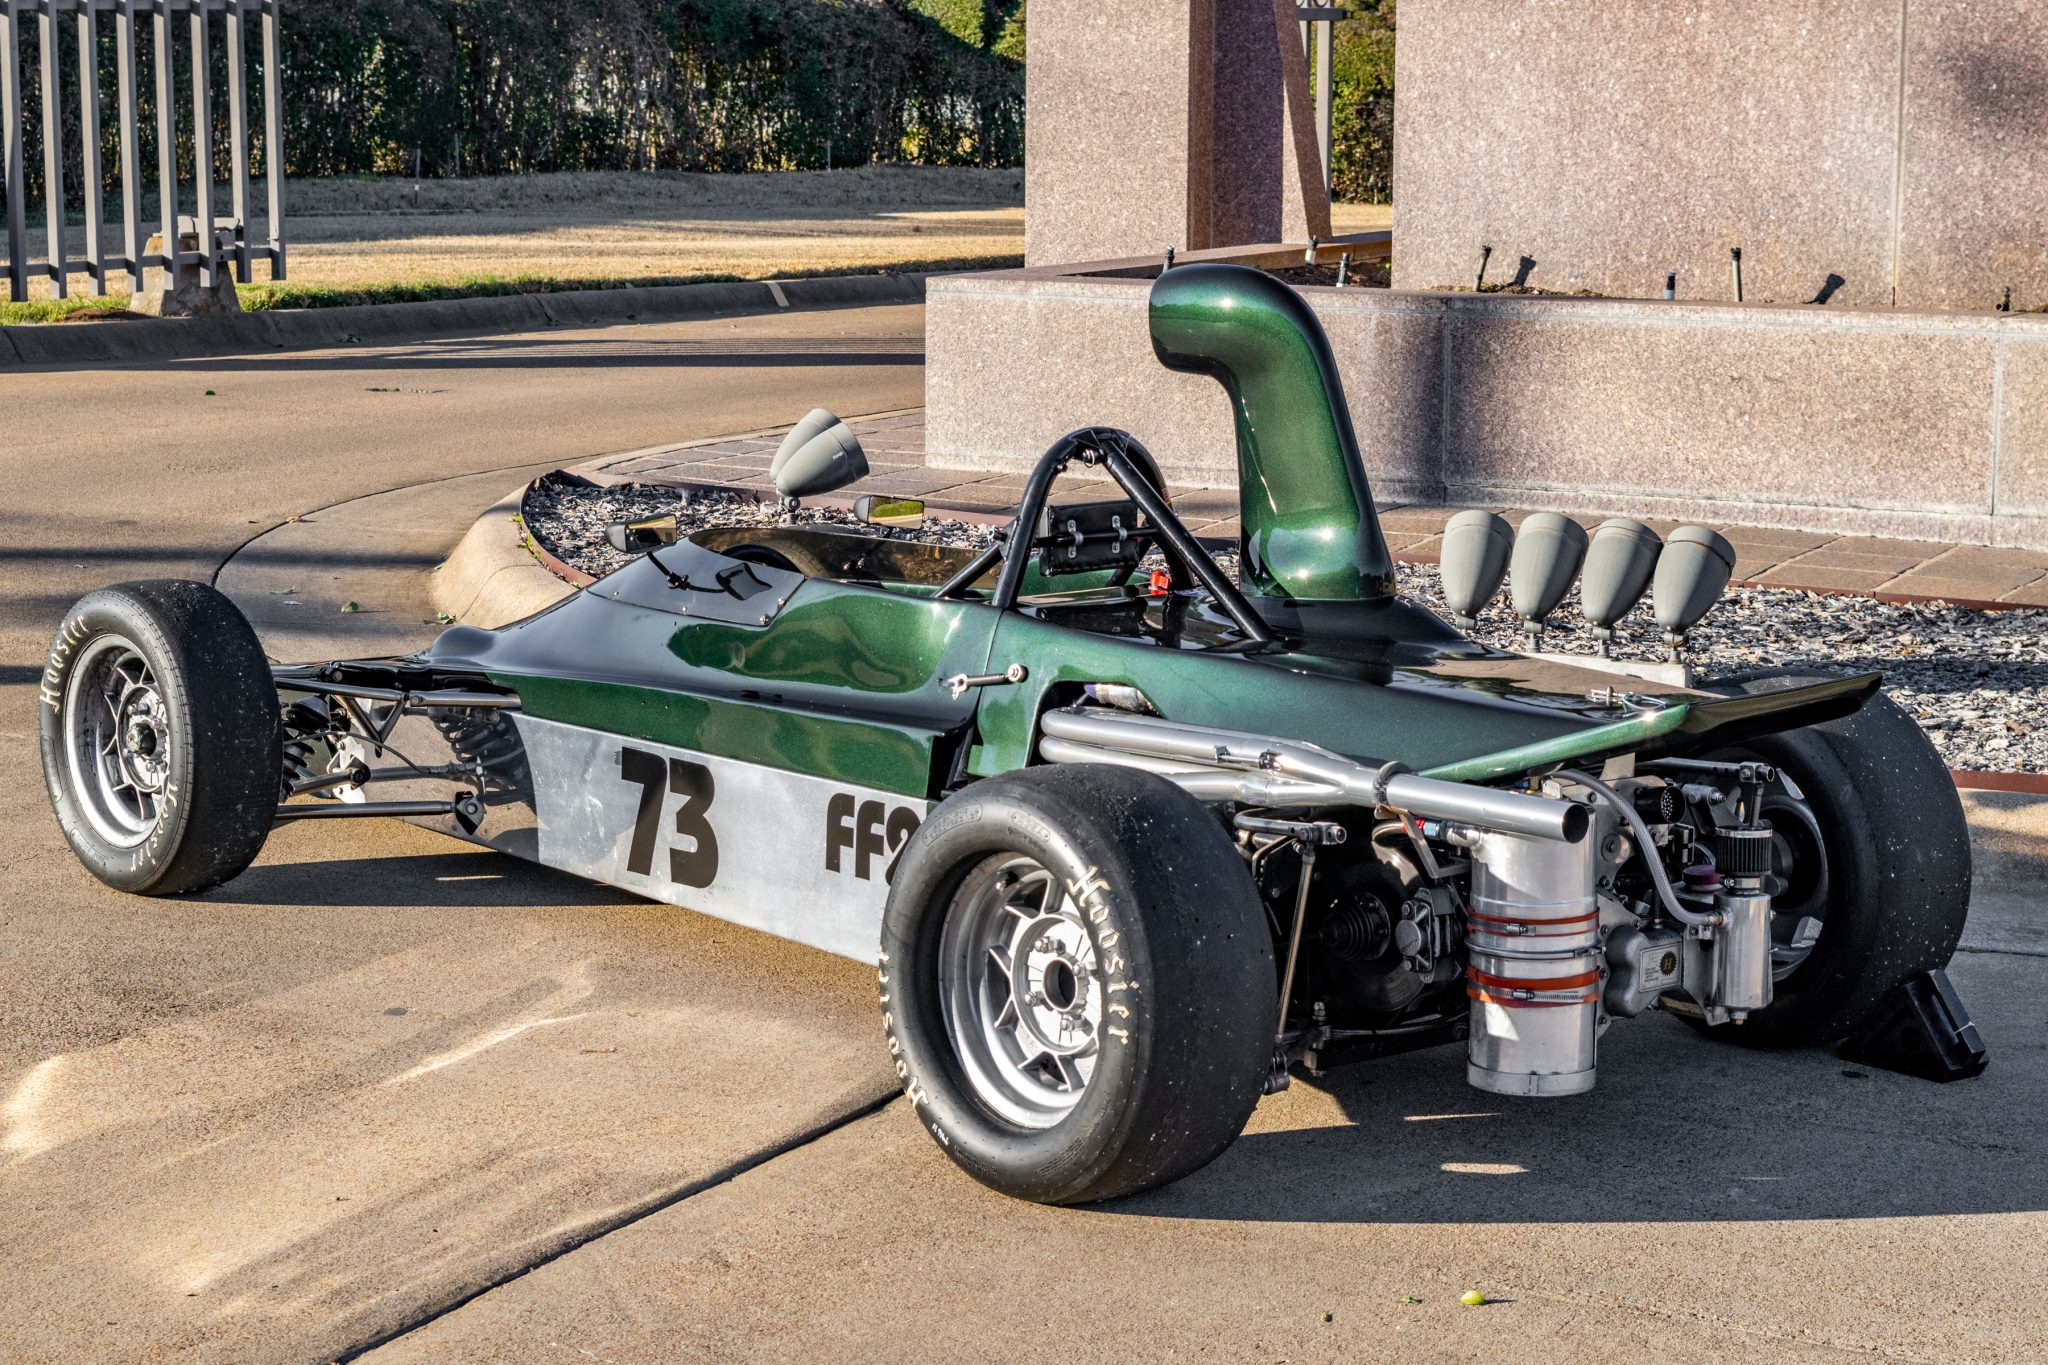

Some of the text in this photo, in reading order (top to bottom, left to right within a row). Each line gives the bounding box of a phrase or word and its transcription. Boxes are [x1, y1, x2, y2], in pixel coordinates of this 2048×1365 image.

[40, 613, 90, 714] Hoosier
[621, 746, 719, 889] 73
[1066, 865, 1140, 1046] Hoosier
